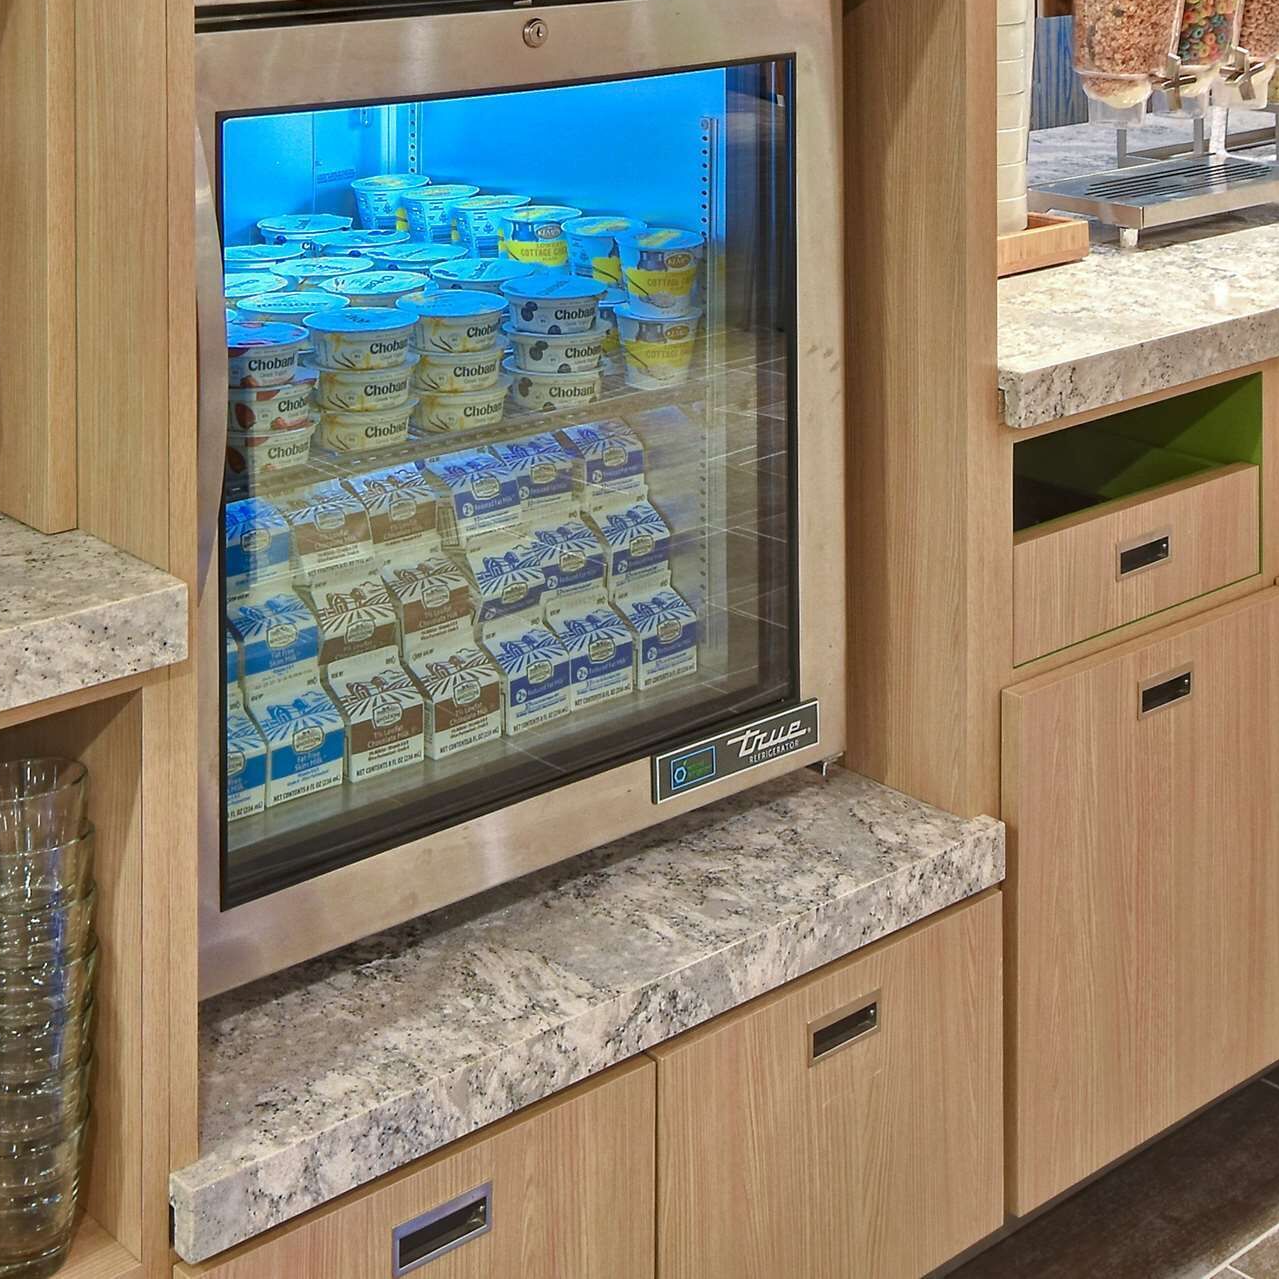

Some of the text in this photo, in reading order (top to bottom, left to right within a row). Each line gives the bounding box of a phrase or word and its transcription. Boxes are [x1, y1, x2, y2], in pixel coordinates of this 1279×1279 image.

[248, 352, 295, 371] Chobani
[548, 383, 595, 398] Chobani
[440, 745, 448, 753] NET
[748, 739, 800, 764] REFRIGERATOR
[356, 768, 365, 776] NET
[365, 761, 388, 774] CONTENTS
[273, 792, 282, 801] NET
[282, 785, 306, 798] CONTENTS
